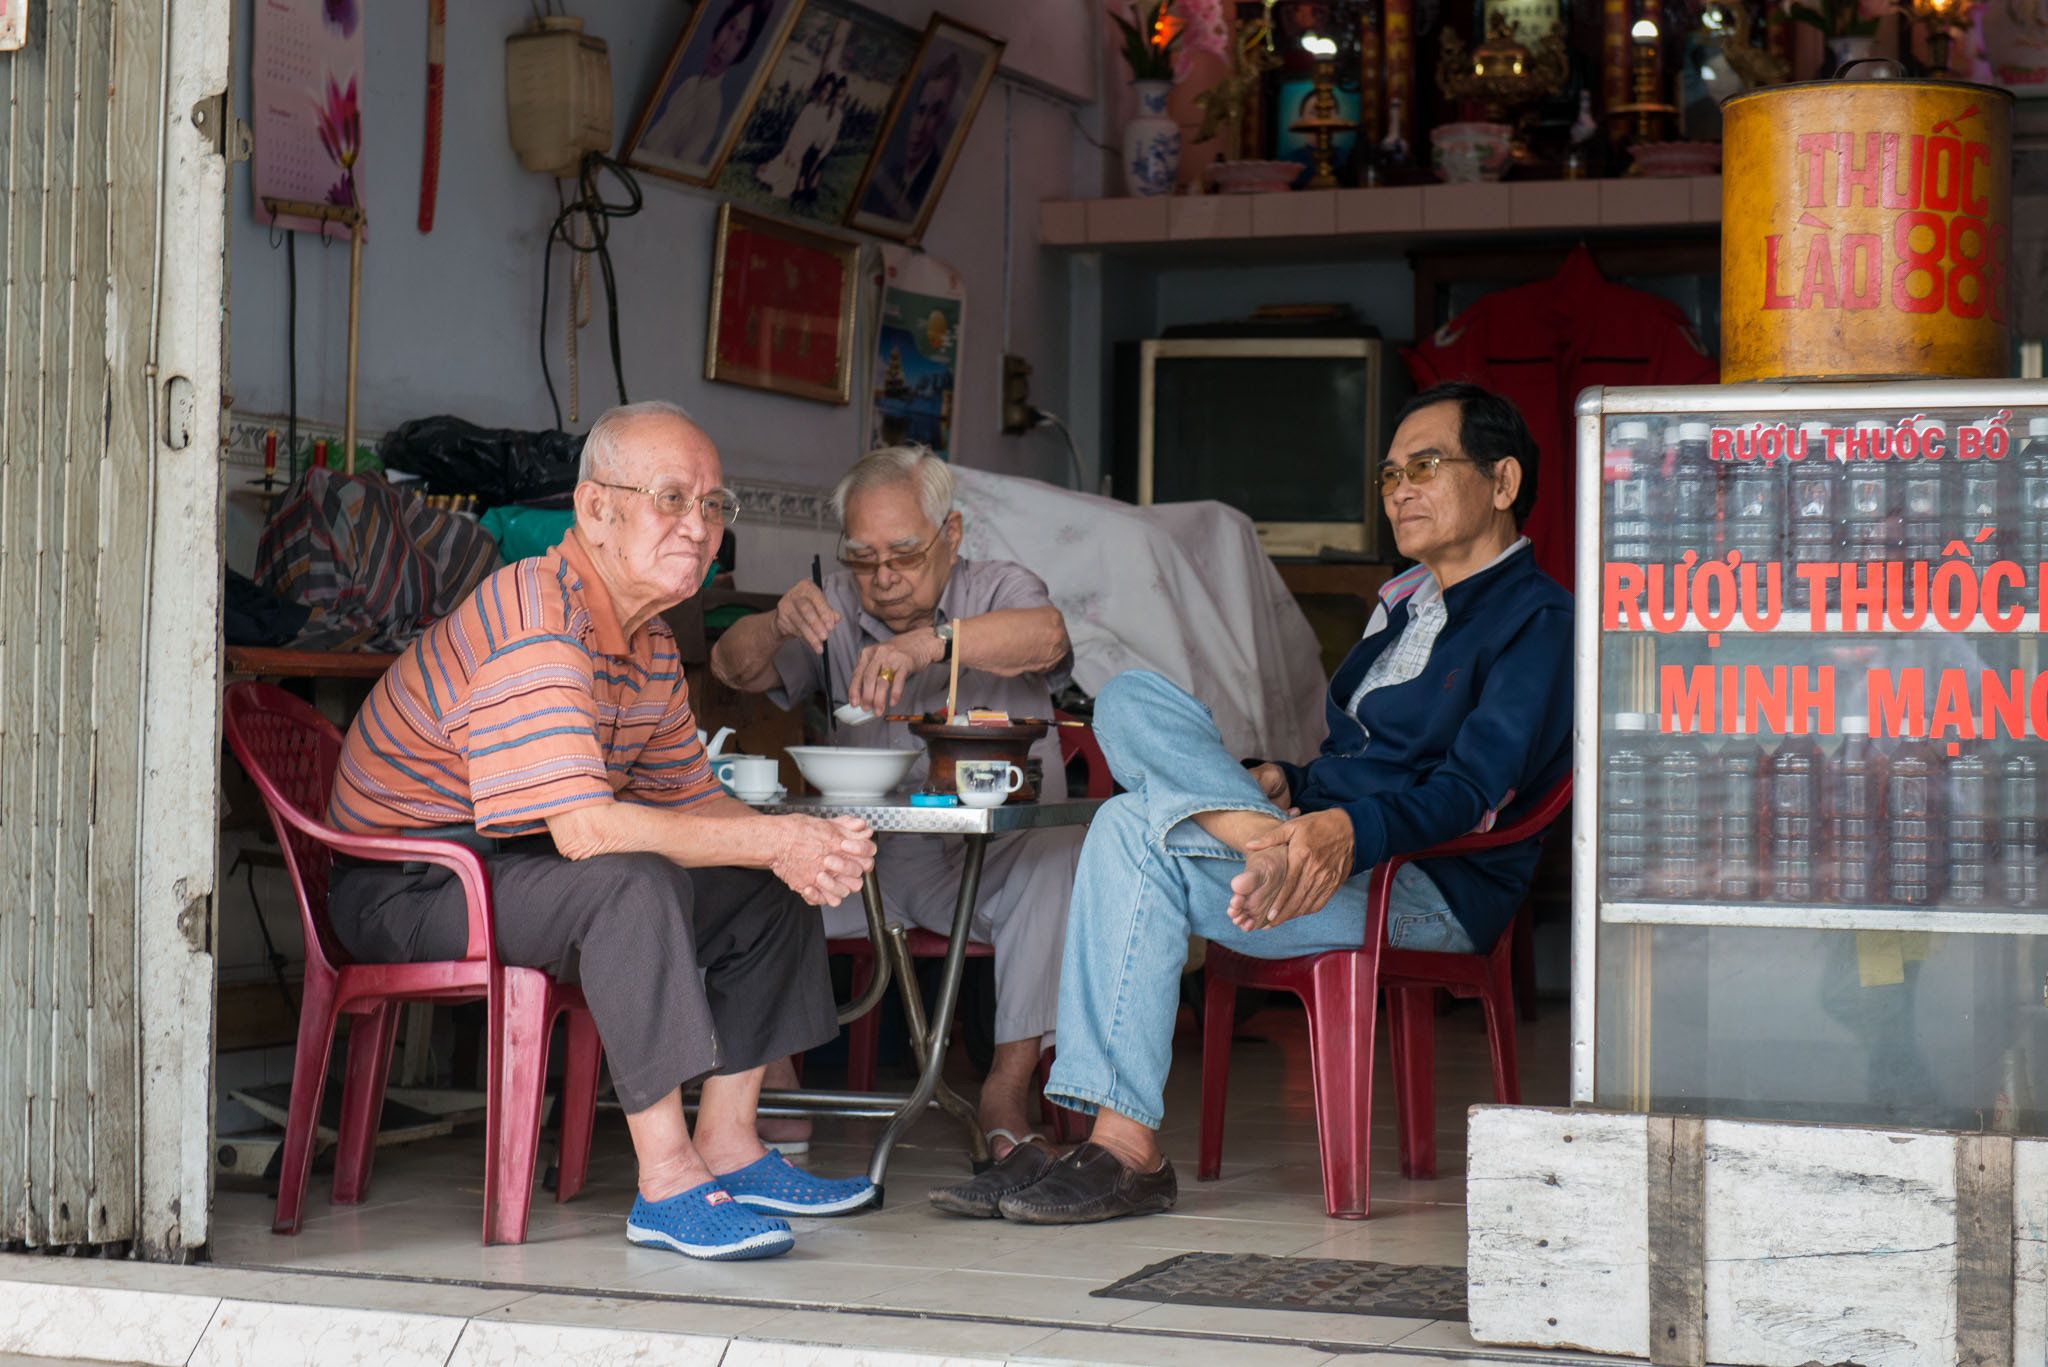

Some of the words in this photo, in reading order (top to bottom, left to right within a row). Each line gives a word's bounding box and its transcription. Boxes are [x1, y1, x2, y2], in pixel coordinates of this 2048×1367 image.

[1798, 104, 1991, 218] THUỐC
[1761, 211, 1882, 311] LÀO
[1709, 422, 1808, 467] RƯỢU
[1821, 413, 1947, 461] THUỐC
[1957, 408, 2013, 460] BỔ
[1603, 549, 1782, 648] RƯỢU
[1796, 527, 2026, 633] THUỐC
[1660, 665, 1835, 735] MINH
